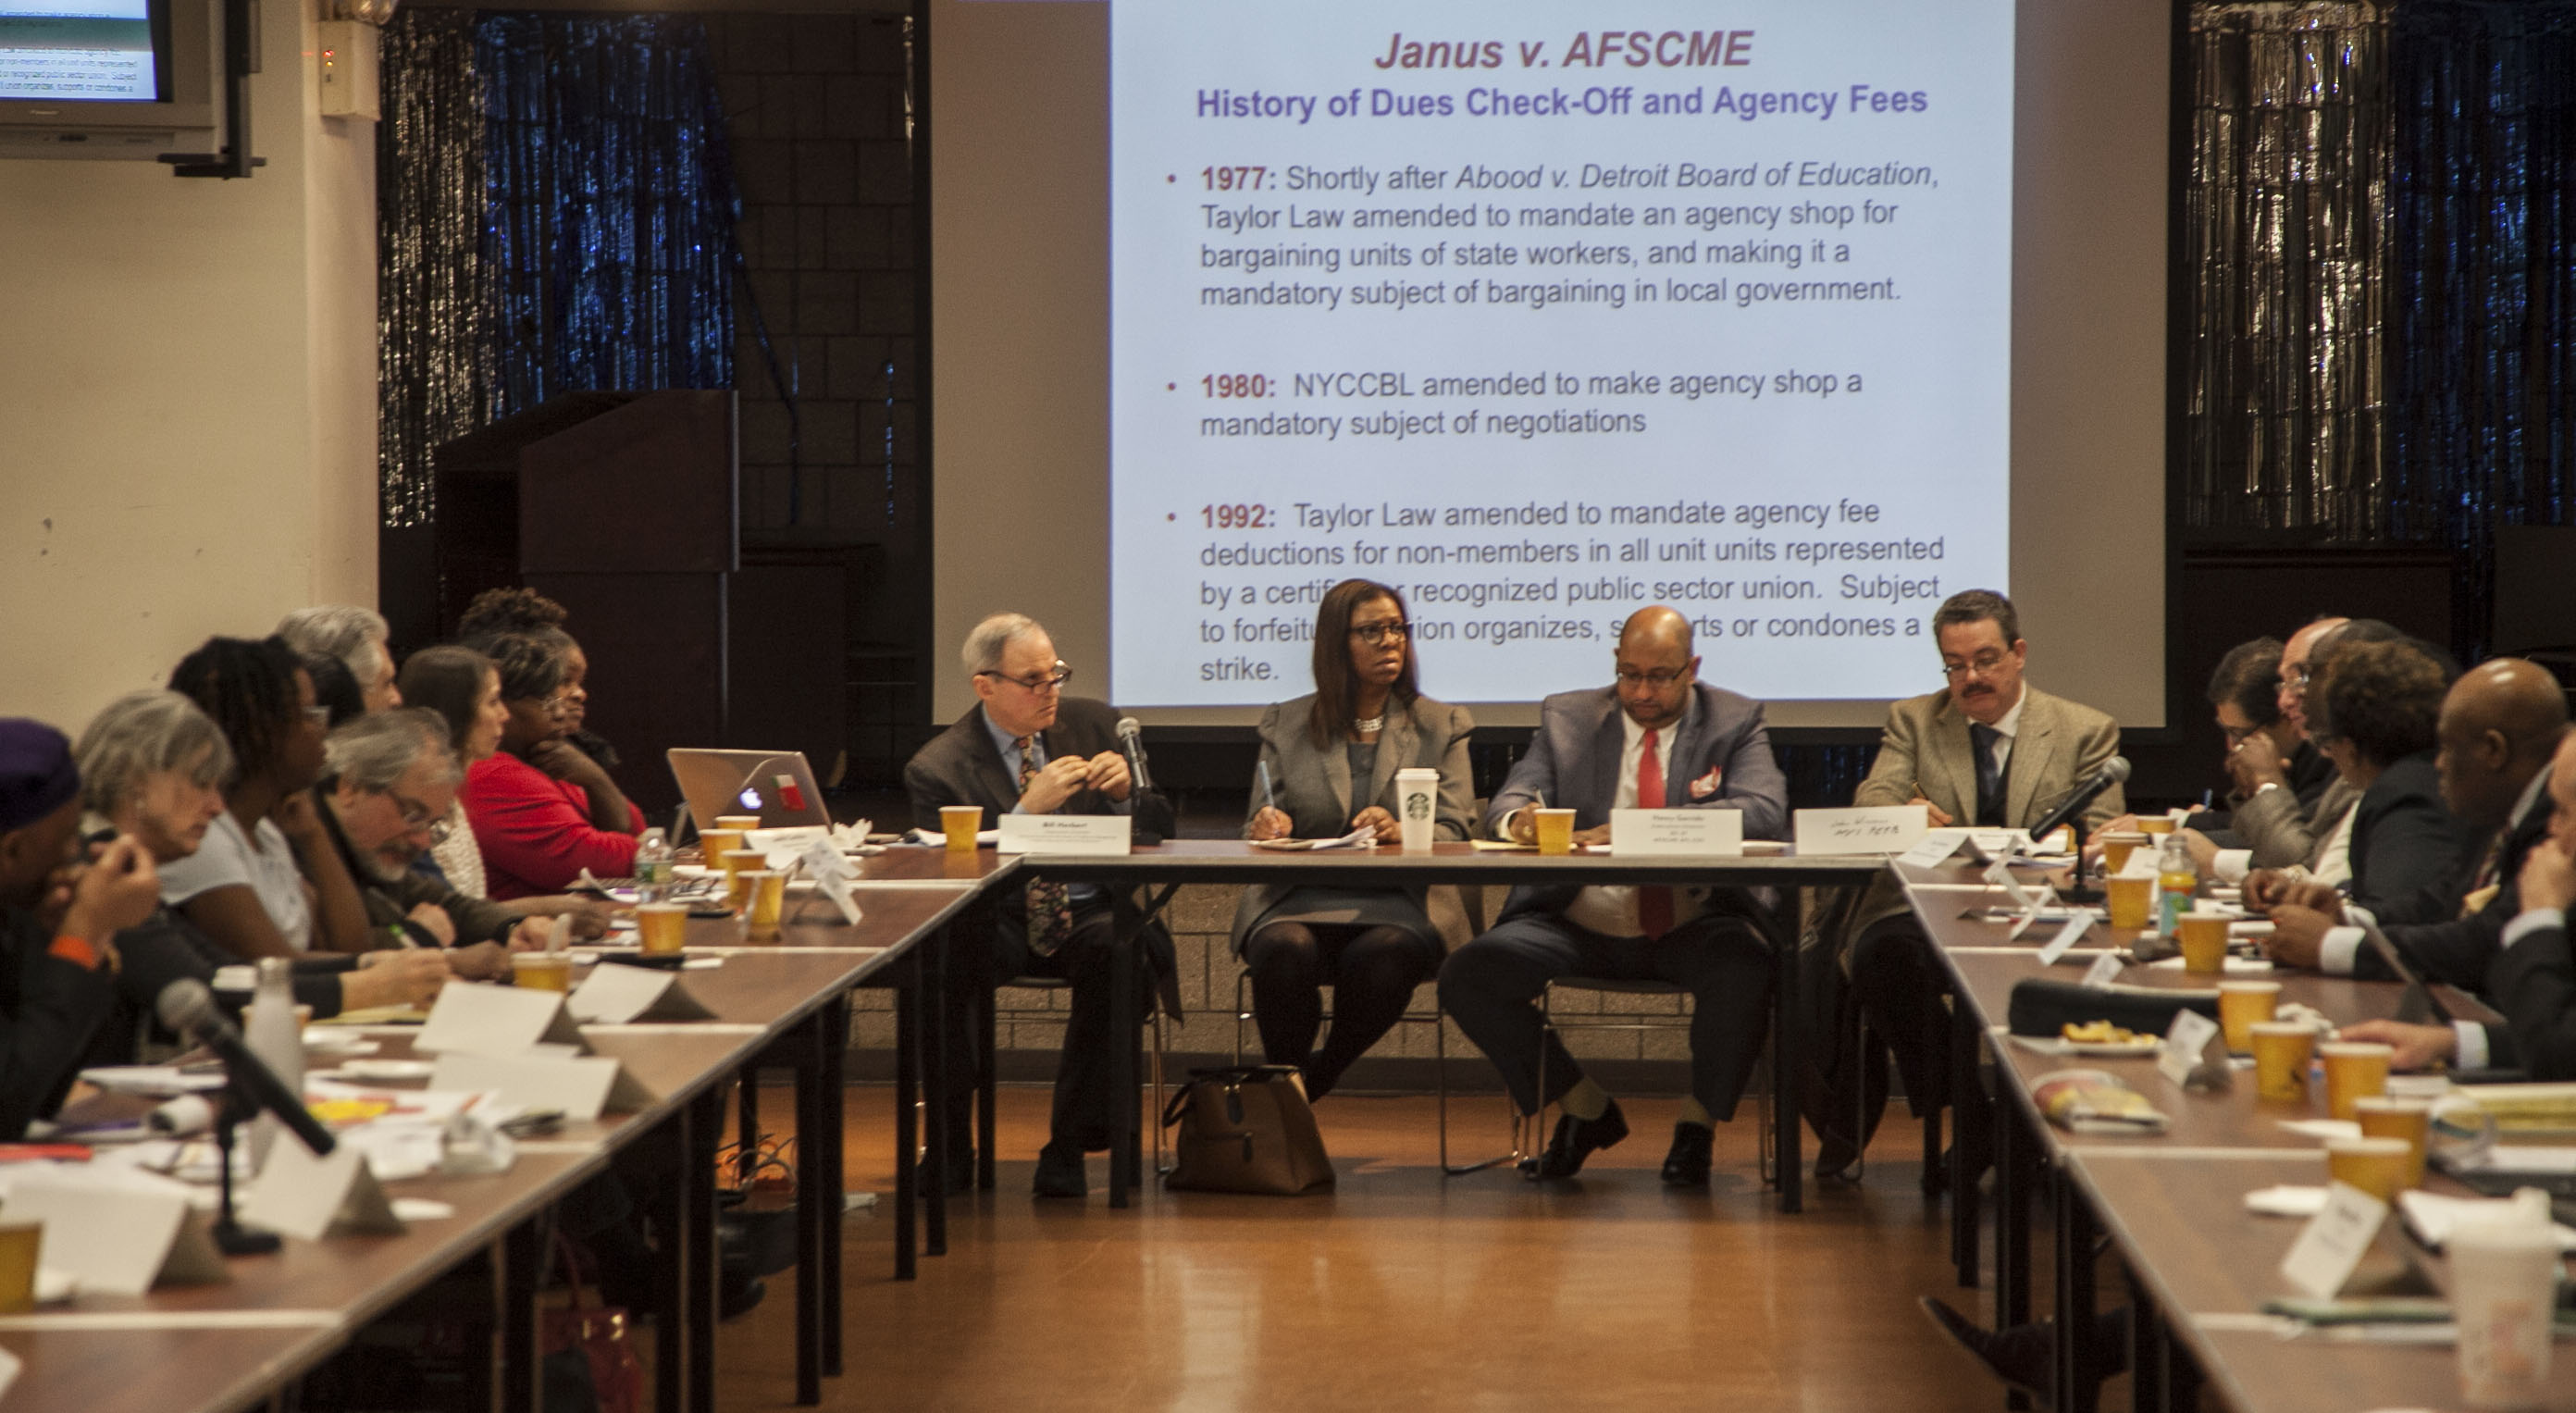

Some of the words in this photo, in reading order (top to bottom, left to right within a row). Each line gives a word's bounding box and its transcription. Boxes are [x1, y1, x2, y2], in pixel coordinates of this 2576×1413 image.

[1374, 32, 1505, 69] Janus
[1518, 41, 1549, 68] v.
[1561, 30, 1754, 68] AFSCME
[1197, 89, 1317, 125] History
[1328, 88, 1362, 118] of
[1370, 89, 1455, 117] Dues
[1466, 86, 1634, 117] Check-Off
[1642, 86, 1703, 115] and
[1712, 86, 1839, 122] Agency
[1850, 84, 1928, 113] Fees
[1202, 166, 1276, 191] 1977:
[1286, 165, 1380, 195] Shortly
[1388, 165, 1448, 190] after
[1455, 165, 1543, 189] Abood
[1552, 170, 1569, 188] v.
[1579, 163, 1669, 189] Detroit
[1677, 163, 1758, 187] Board
[1765, 161, 1793, 187] of
[1798, 161, 1938, 188] Education,
[1201, 205, 1282, 235] Taylor
[1290, 204, 1344, 229] Law
[1353, 203, 1477, 228] amended
[1486, 204, 1510, 227] to
[1520, 202, 1634, 227] mandate
[1643, 207, 1676, 226] an
[1685, 206, 1781, 231] agency
[1790, 200, 1854, 229] shop
[1863, 199, 1899, 224] for
[1201, 242, 1340, 274] bargaining
[1350, 242, 1412, 266] units
[1421, 242, 1446, 266] of
[1455, 242, 1517, 266] state
[1527, 241, 1638, 267] workers,
[1648, 240, 1696, 264] and
[1707, 239, 1802, 269] making
[1812, 239, 1826, 262] it
[1834, 244, 1850, 263] a
[1201, 281, 1343, 311] mandatory
[1351, 280, 1445, 311] subject
[1454, 279, 1480, 304] of
[1488, 279, 1626, 310] bargaining
[1635, 279, 1657, 302] in
[1667, 278, 1727, 302] local
[1736, 277, 1901, 307] government.
[1202, 373, 1276, 398] 1980:
[1294, 372, 1415, 397] NYCCBL
[1422, 371, 1546, 396] amended
[1555, 372, 1579, 395] to
[1589, 370, 1661, 394] make
[1669, 375, 1765, 401] agency
[1774, 368, 1838, 399] shop
[1847, 374, 1862, 392] a
[1201, 412, 1342, 441] mandatory
[1351, 410, 1445, 440] subject
[1453, 409, 1479, 434] of
[1487, 409, 1646, 440] negotiations
[1201, 503, 1275, 528] 1992:
[1294, 502, 1374, 533] Taylor
[1382, 502, 1436, 527] Law
[1444, 501, 1567, 526] amended
[1577, 502, 1602, 525] to
[1611, 500, 1726, 525] mandate
[1735, 504, 1831, 529] agency
[1839, 498, 1880, 523] fee
[1201, 541, 1344, 566] deductions
[1354, 540, 1389, 564] for
[1397, 539, 1579, 564] non-members
[1590, 539, 1610, 562] in
[1620, 538, 1649, 562] all
[1659, 538, 1706, 562] unit
[1715, 537, 1777, 561] units
[1786, 536, 1944, 566] represented
[1201, 580, 1232, 611] by
[1241, 586, 1256, 604] a
[1266, 579, 1336, 605] certif
[1414, 576, 1557, 608] recognized
[1567, 576, 1645, 607] public
[1654, 578, 1736, 601] sector
[1743, 575, 1822, 600] union.
[1840, 574, 1940, 605] Subject
[1200, 620, 1225, 642] to
[1233, 617, 1317, 642] forfeit
[1464, 614, 1600, 646] organizes,
[1732, 619, 1759, 637] or
[1767, 612, 1896, 637] condones
[1904, 618, 1920, 637] a
[1201, 656, 1278, 681] strike.
